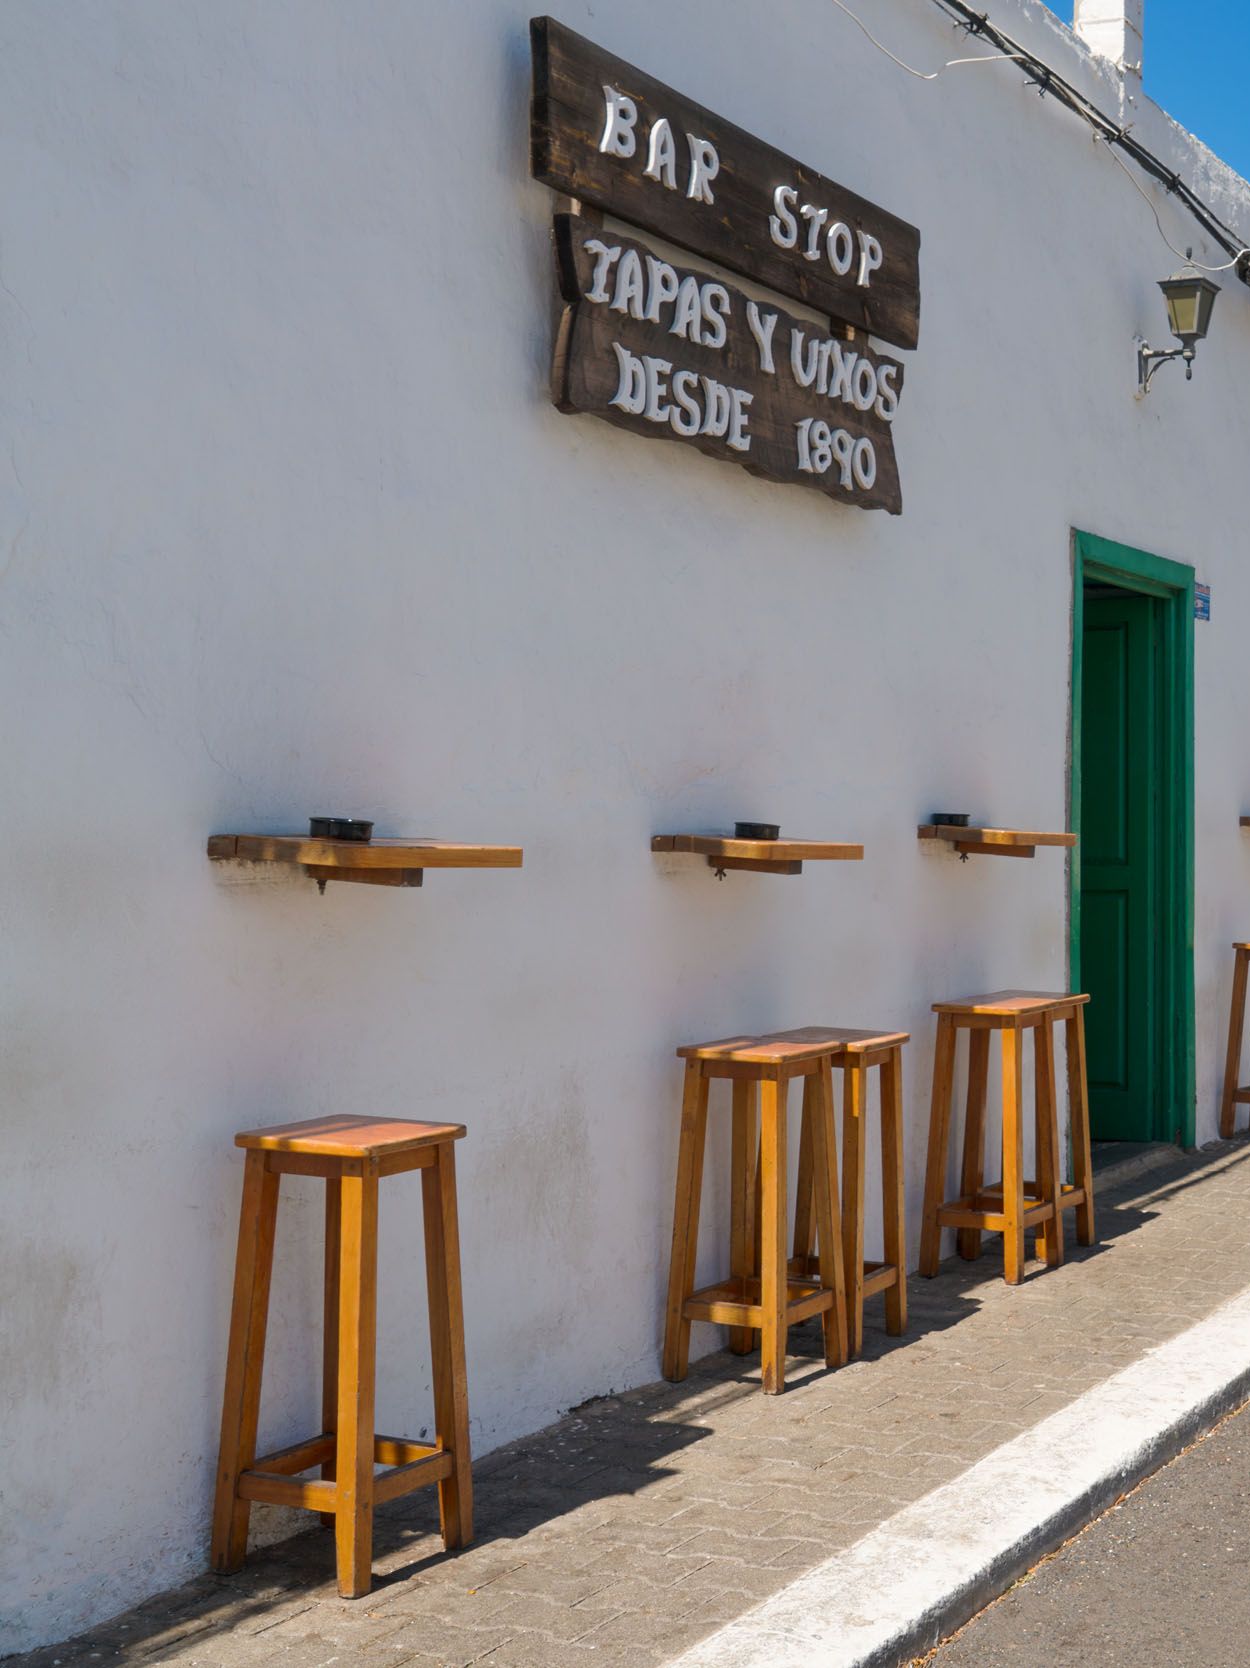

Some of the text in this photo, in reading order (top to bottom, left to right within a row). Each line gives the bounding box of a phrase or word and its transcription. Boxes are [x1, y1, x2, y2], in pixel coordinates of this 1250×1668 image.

[600, 85, 883, 288] BAR STOP
[583, 239, 731, 349] TAPAS
[746, 301, 778, 374] Y
[609, 342, 877, 491] DESDE 1890
